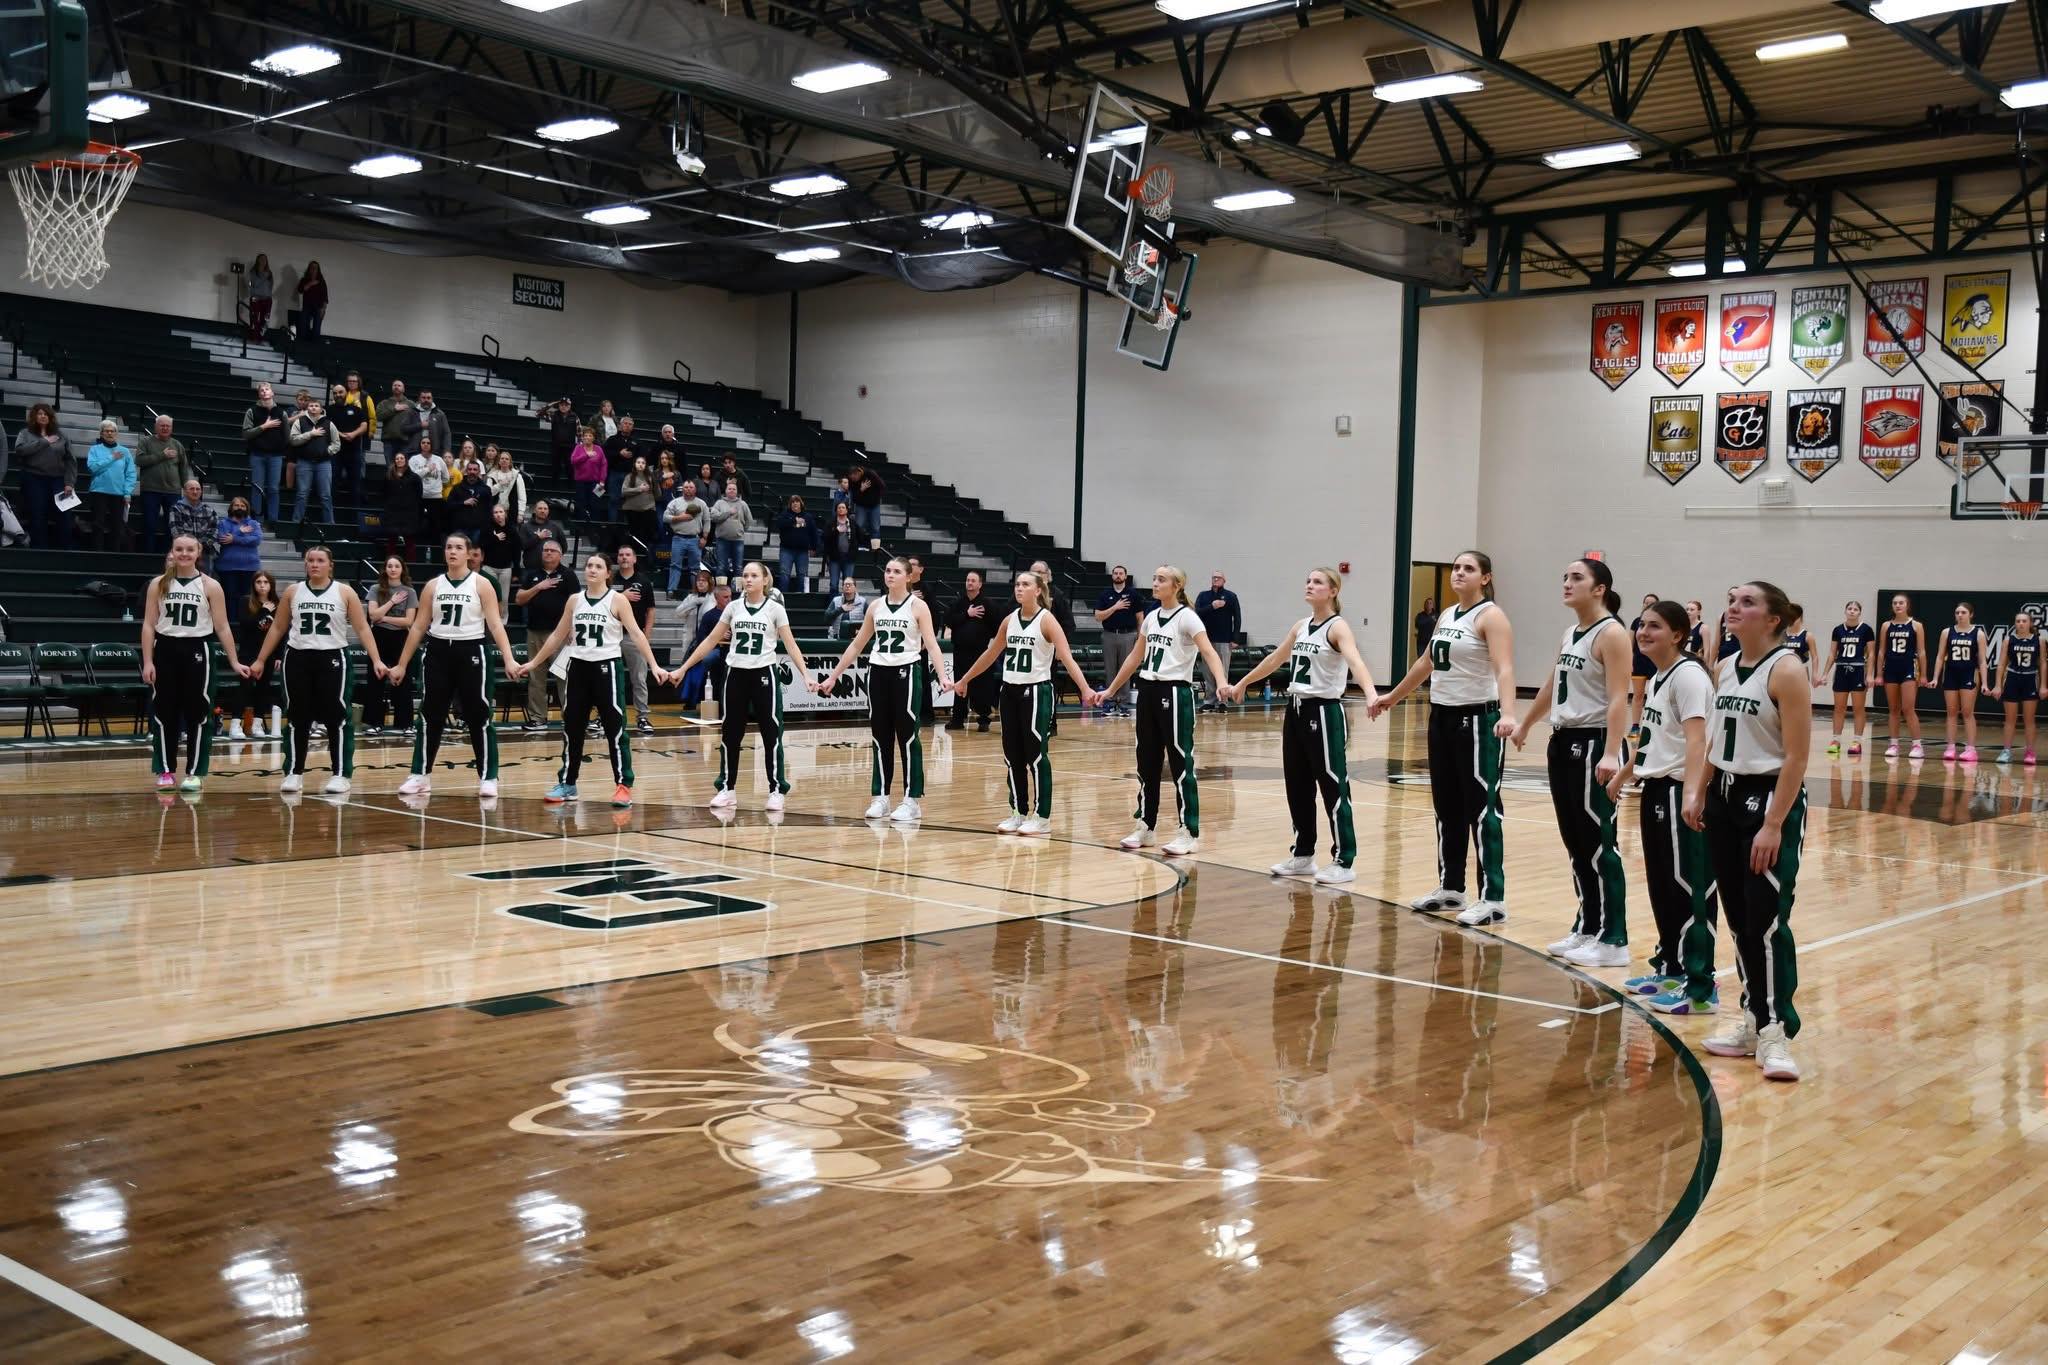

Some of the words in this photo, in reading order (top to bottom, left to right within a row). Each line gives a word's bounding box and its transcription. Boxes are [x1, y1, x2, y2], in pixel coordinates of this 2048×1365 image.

[518, 277, 560, 294] VISITOR'S
[1870, 281, 1923, 296] CHIPPEWA
[514, 290, 562, 308] SECTION
[1724, 297, 1739, 309] BIG
[1741, 294, 1773, 306] RAPIDS
[1795, 288, 1846, 304] CENTRAL
[1596, 307, 1618, 318] KENT
[1620, 305, 1640, 317] CITY
[1659, 302, 1682, 314] WHITE
[1684, 300, 1705, 311] CLOUD
[1794, 301, 1846, 319] MONTCALM
[1951, 335, 1998, 347] MOHAWKS
[1594, 356, 1637, 368] EAGLES
[1657, 351, 1703, 365] INDIANS
[1790, 391, 1841, 407] NEWAYGO
[1865, 389, 1892, 403] REED
[1895, 387, 1920, 401] CITY
[1653, 399, 1699, 413] LAKEVIEW
[1652, 450, 1697, 462] WILDCATS
[1788, 446, 1837, 459] LIONS
[1863, 443, 1916, 457] COYOTES
[436, 593, 472, 603] HORNETS
[298, 602, 335, 612] HORNETS
[165, 603, 198, 627] 40
[440, 604, 463, 627] 31
[575, 613, 607, 623] HORNETS
[300, 612, 332, 635] 32
[735, 620, 767, 631] HORNETS
[876, 618, 909, 629] HORNETS
[575, 623, 604, 647] 24
[876, 630, 905, 653] 22
[735, 631, 764, 655] 23
[1892, 638, 1906, 653] 12
[1842, 644, 1856, 658] 10
[1952, 646, 1971, 661] 20
[1006, 647, 1033, 673] 20
[2016, 652, 2032, 668] 13
[1722, 716, 1737, 762] 1
